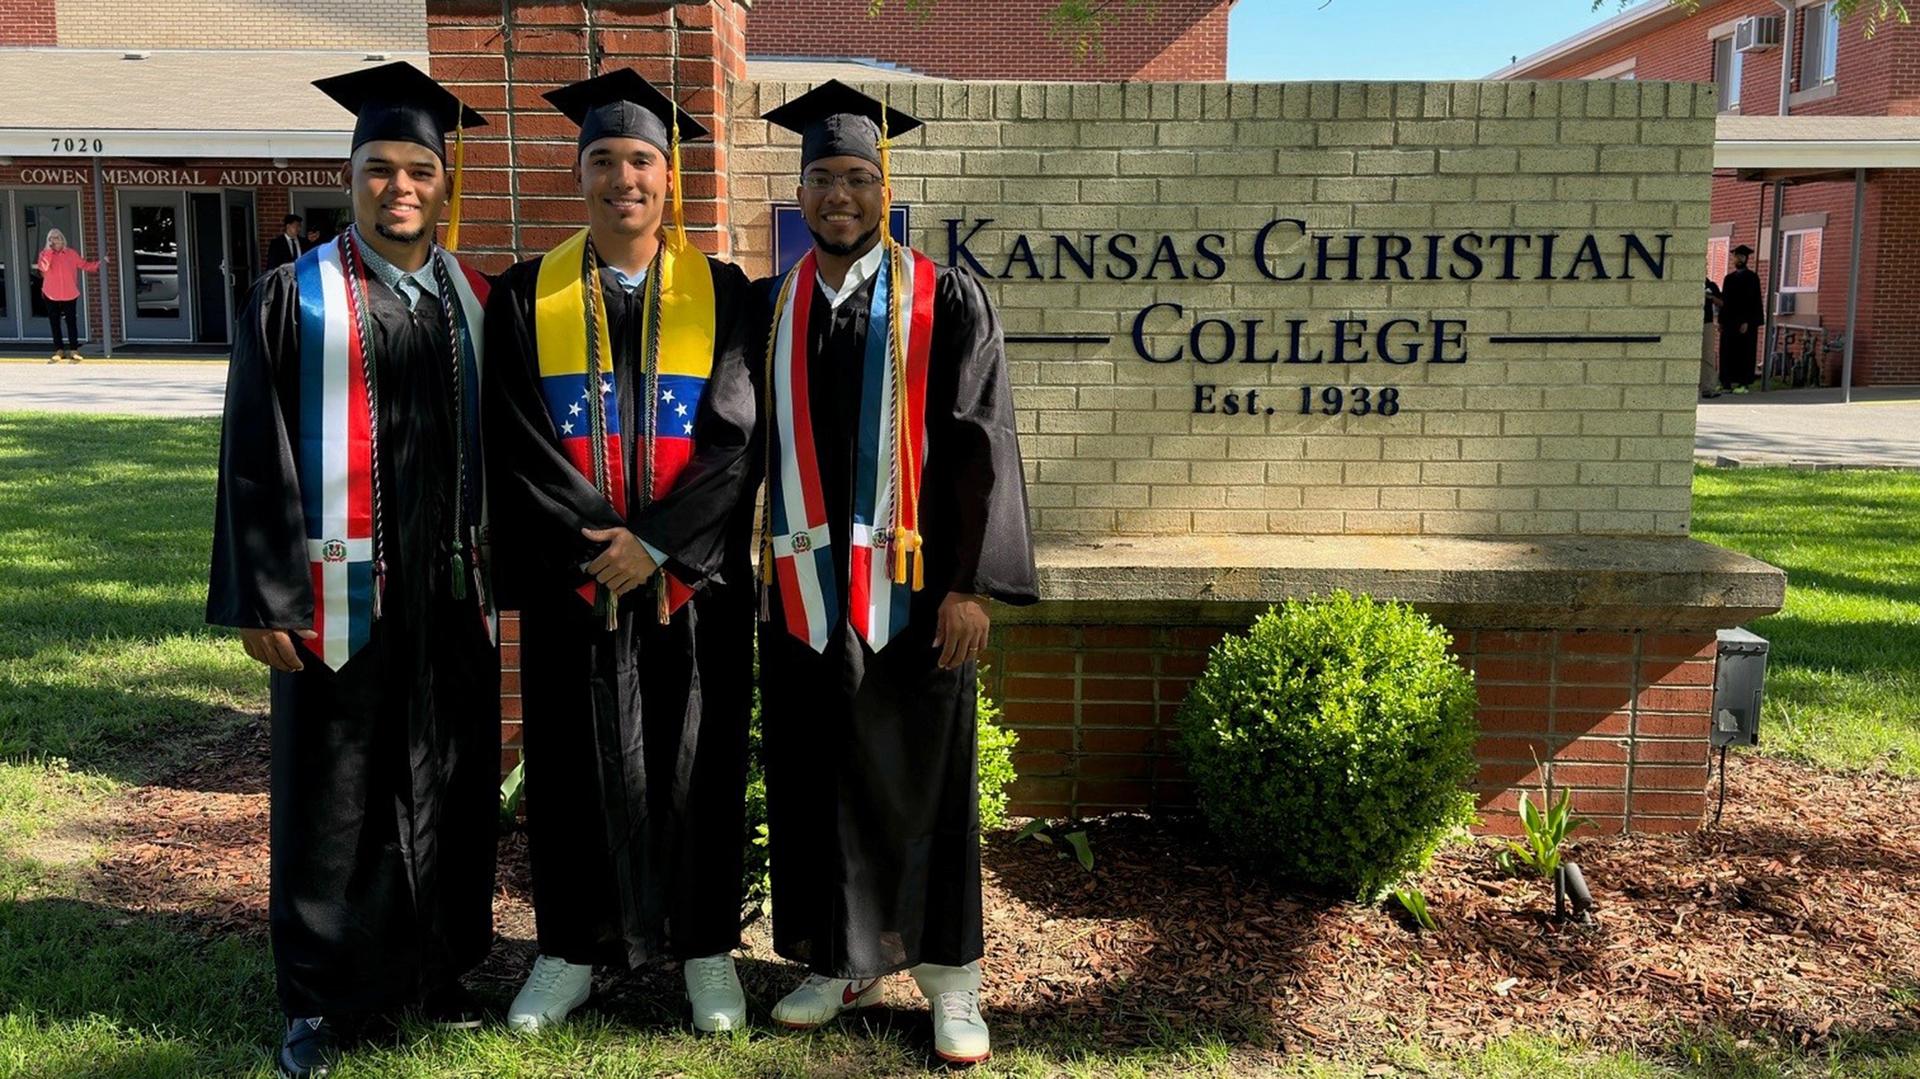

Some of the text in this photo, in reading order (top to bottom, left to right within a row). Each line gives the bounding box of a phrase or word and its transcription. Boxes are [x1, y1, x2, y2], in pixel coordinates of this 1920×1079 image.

[51, 138, 103, 153] 7020
[20, 169, 342, 186] COWEN MEMORIAL AUDITORIUM
[942, 218, 1673, 281] KANSAS CHRISTIAN
[1132, 302, 1468, 364] COLLEGE
[1193, 385, 1400, 416] Est. 1938
